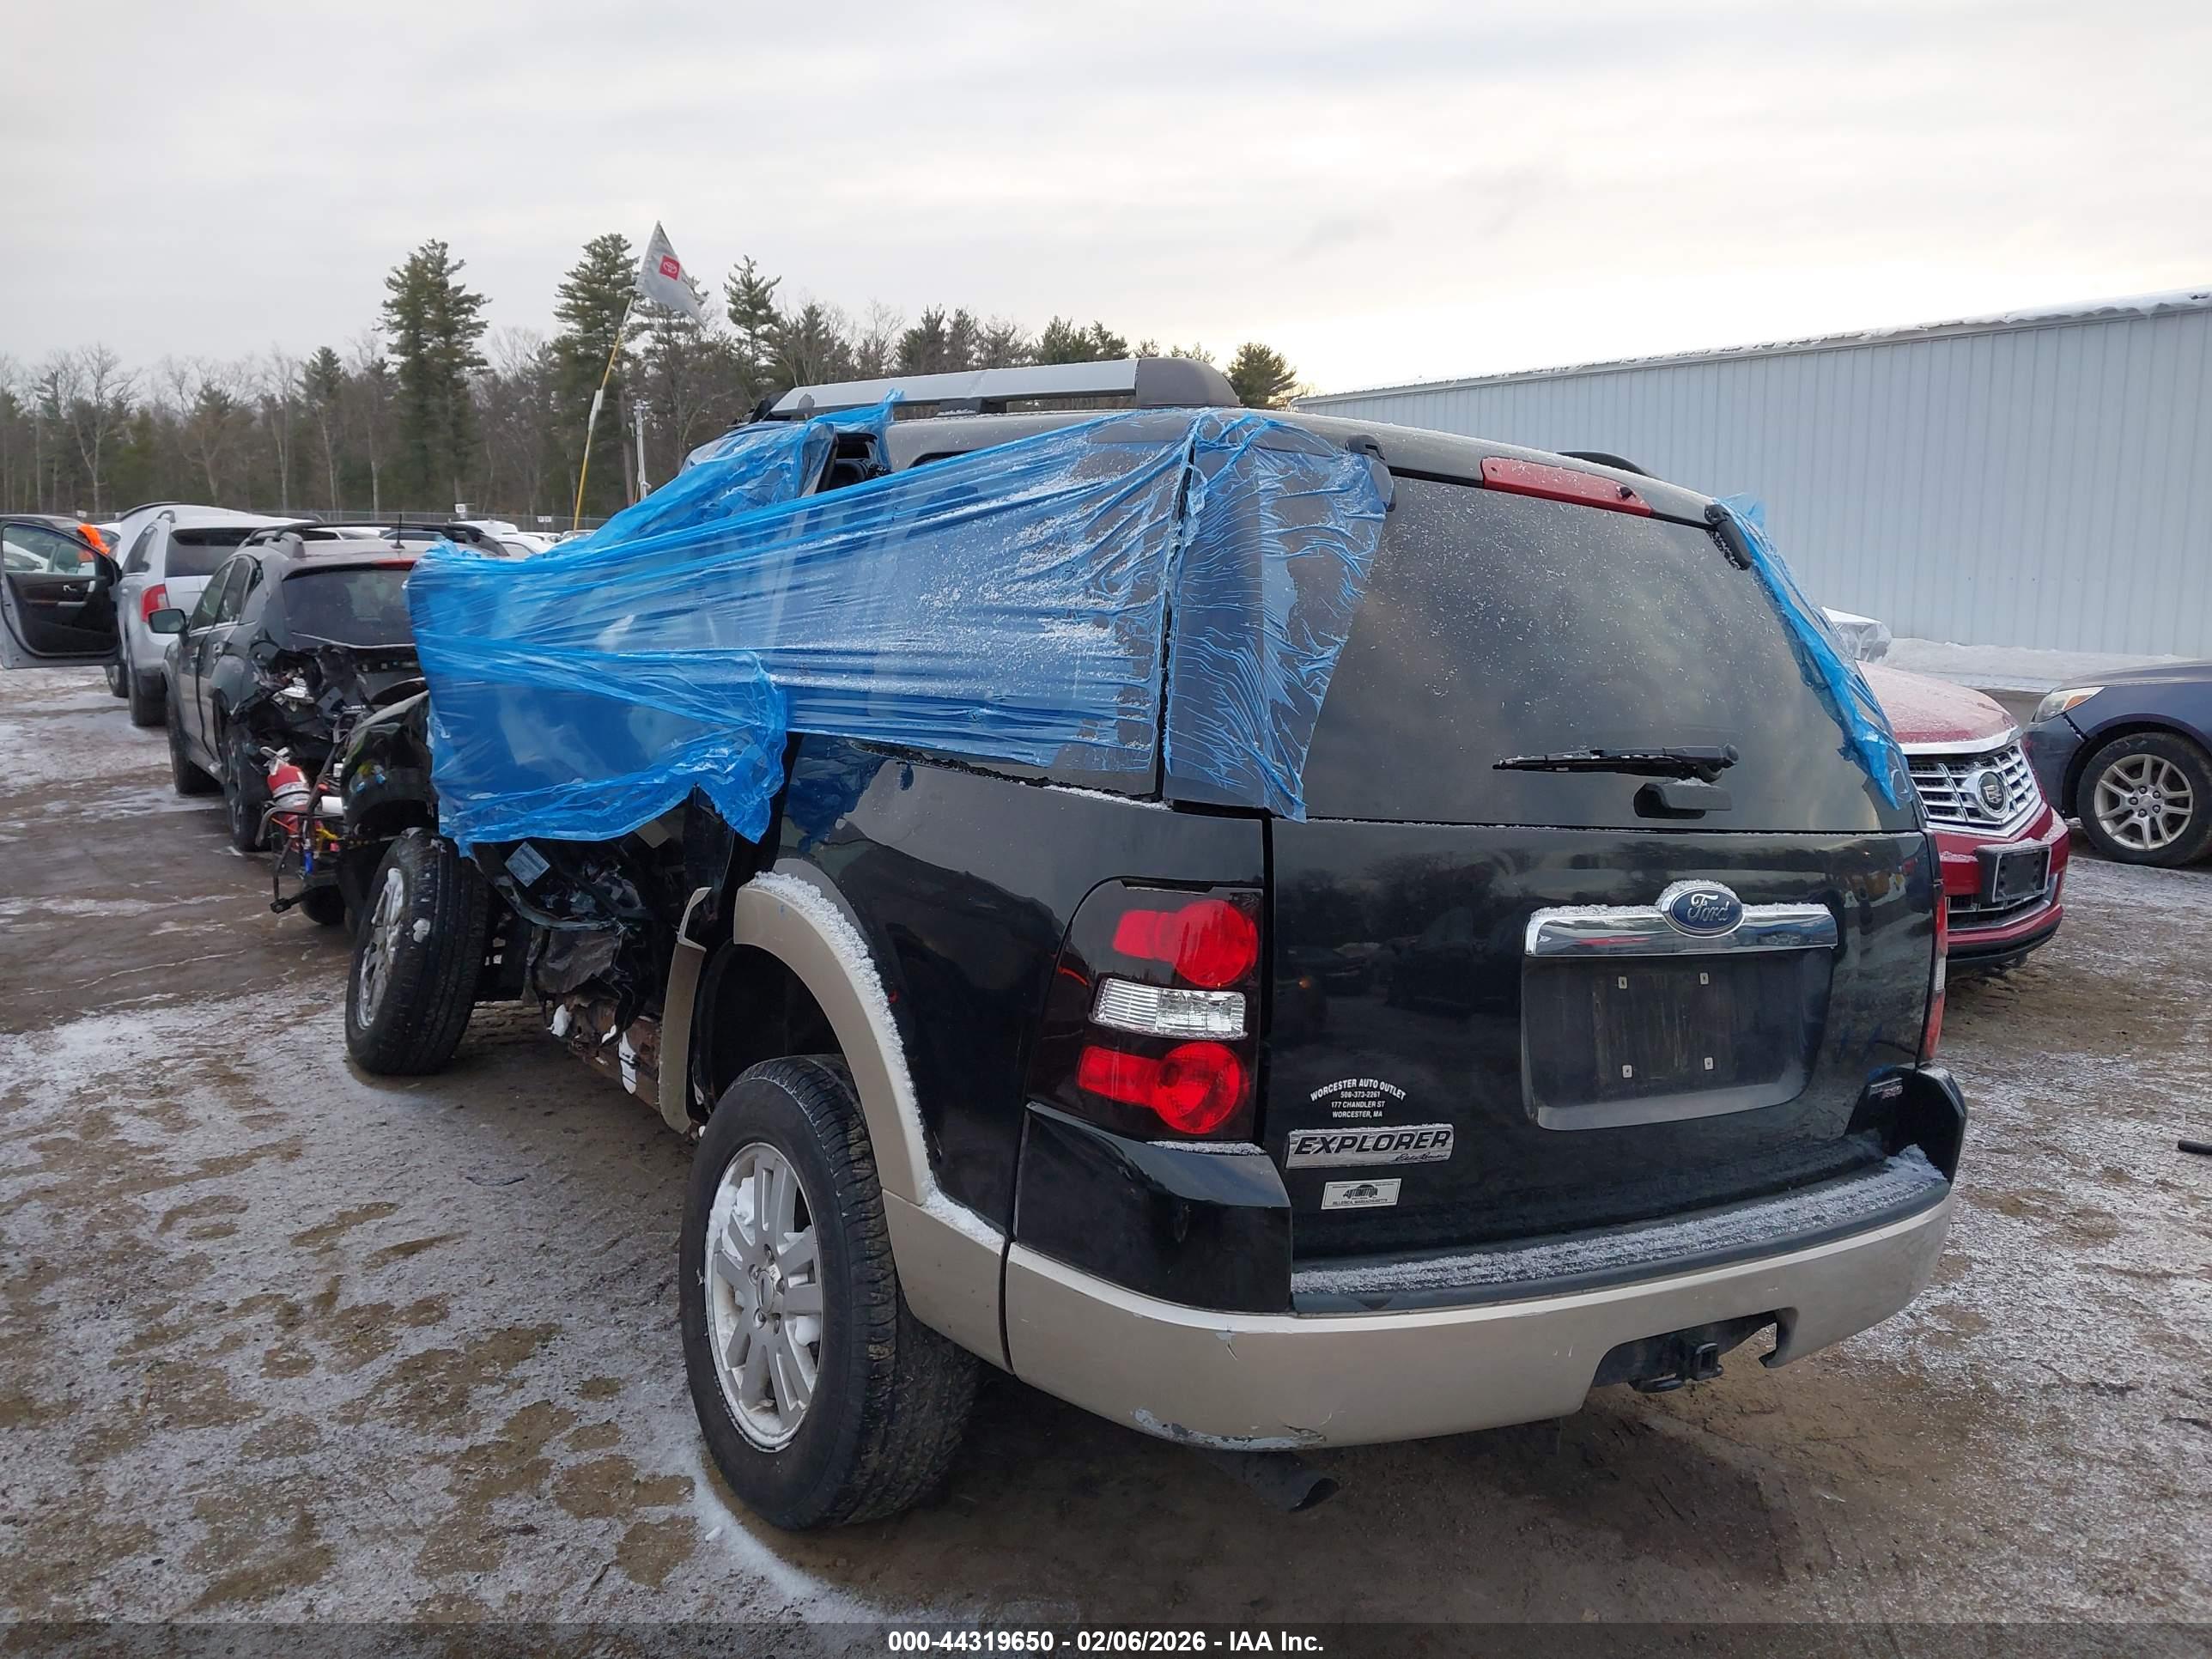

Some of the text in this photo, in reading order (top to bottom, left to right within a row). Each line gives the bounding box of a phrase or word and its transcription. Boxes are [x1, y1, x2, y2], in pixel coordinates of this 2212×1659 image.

[1686, 893, 1729, 922] Ford
[1310, 1079, 1406, 1102] WORCESTER AUTO OUTLET
[1293, 1130, 1451, 1155] EXPLORER
